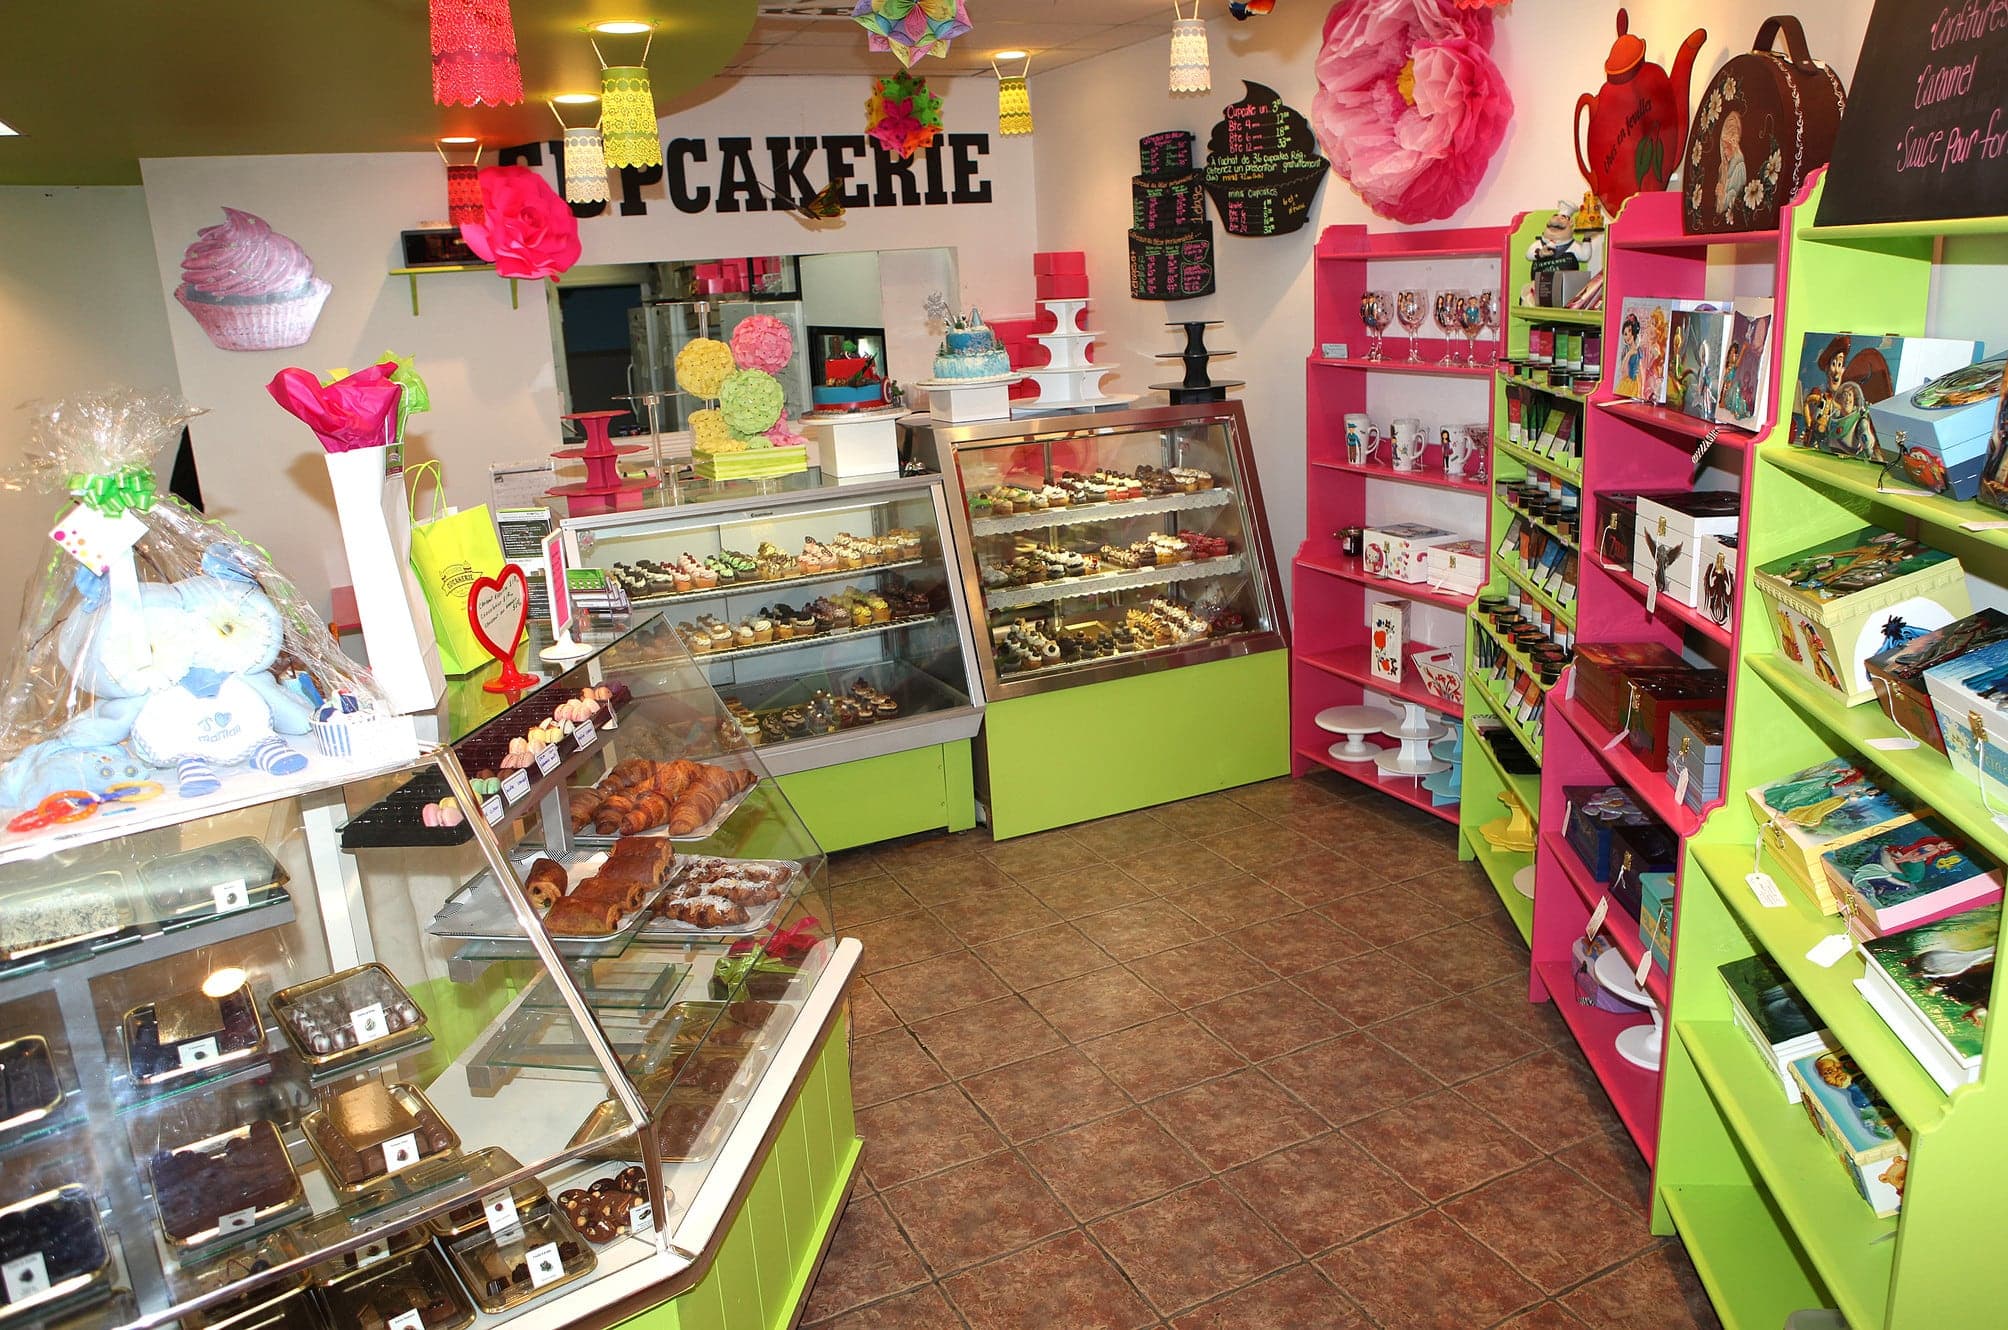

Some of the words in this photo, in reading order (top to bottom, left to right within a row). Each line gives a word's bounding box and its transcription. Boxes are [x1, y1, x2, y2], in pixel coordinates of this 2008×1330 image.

[1914, 55, 1978, 110] Caramel
[498, 133, 992, 219] PCAKERIE
[1896, 126, 1944, 173] Sauce
